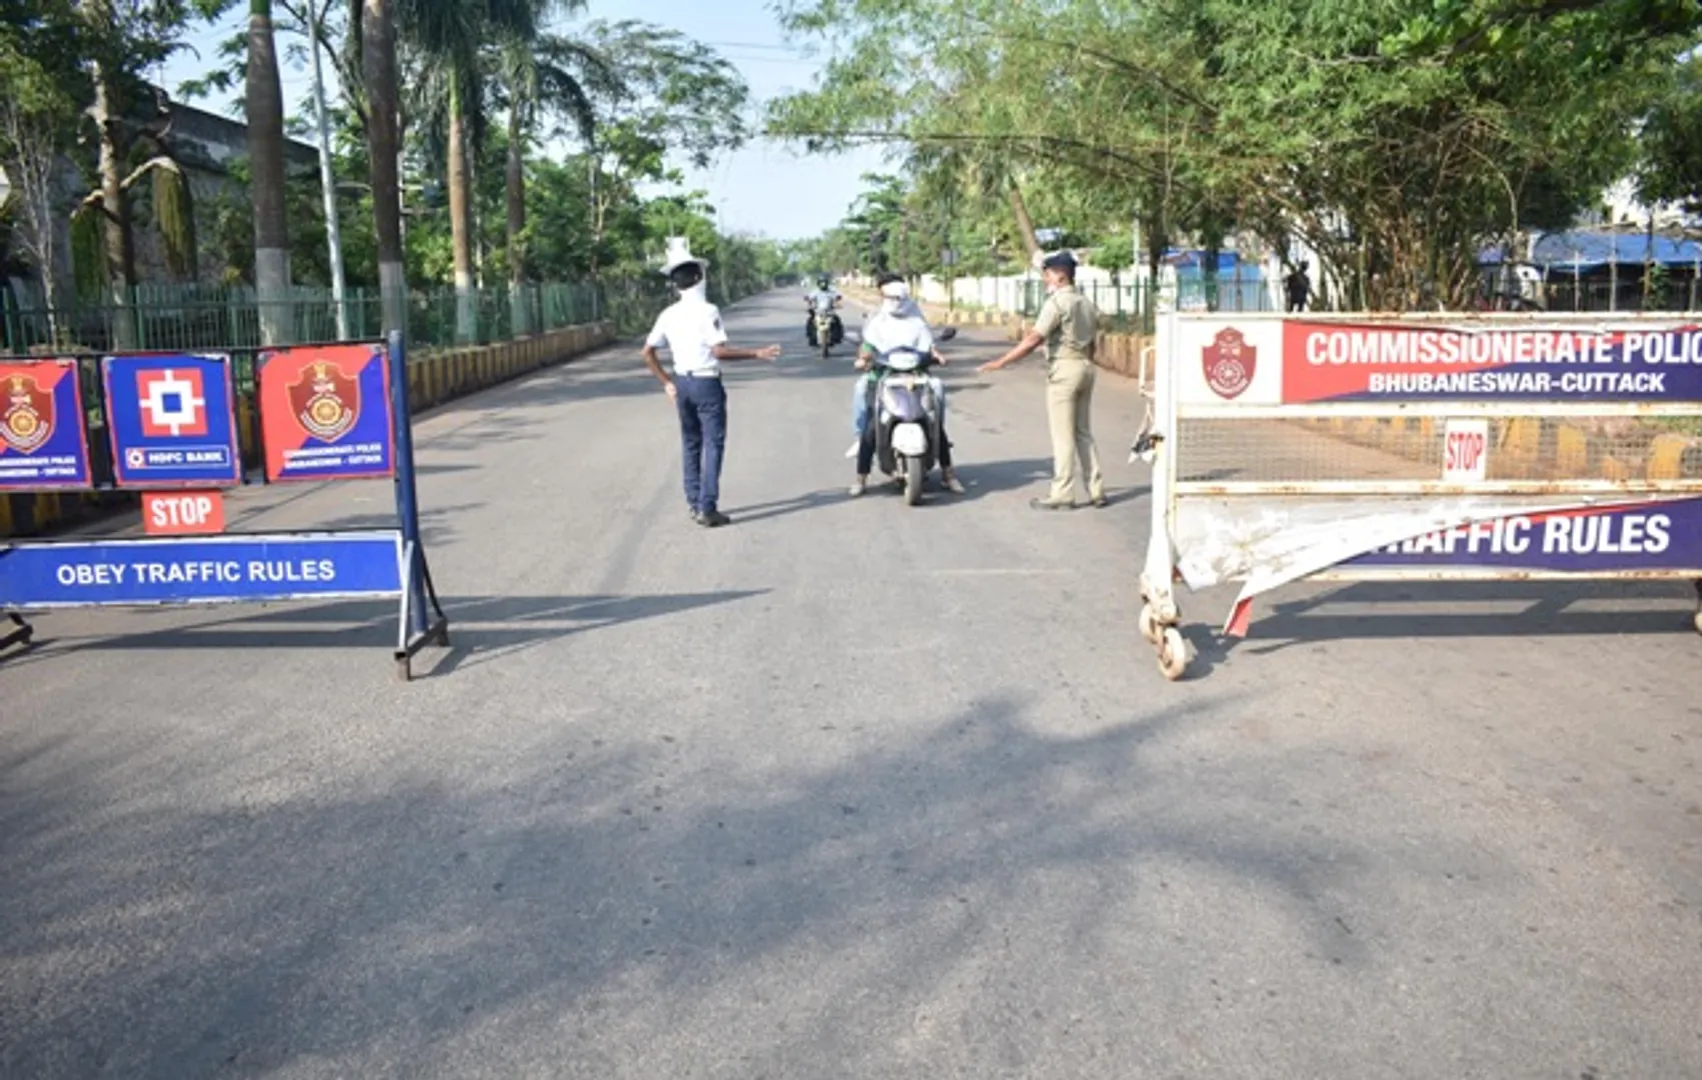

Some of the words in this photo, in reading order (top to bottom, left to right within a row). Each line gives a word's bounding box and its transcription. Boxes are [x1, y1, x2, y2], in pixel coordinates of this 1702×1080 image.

[1306, 331, 1614, 365] COMMISSIONERATE
[1369, 372, 1666, 392] BHUBANESWAR-CUTTACK
[1447, 431, 1483, 470] STOP
[151, 497, 212, 526] STOP
[1542, 514, 1672, 553] RULES
[57, 564, 125, 585] OBEY
[133, 561, 241, 583] TRAFFIC
[248, 560, 335, 582] RULES
